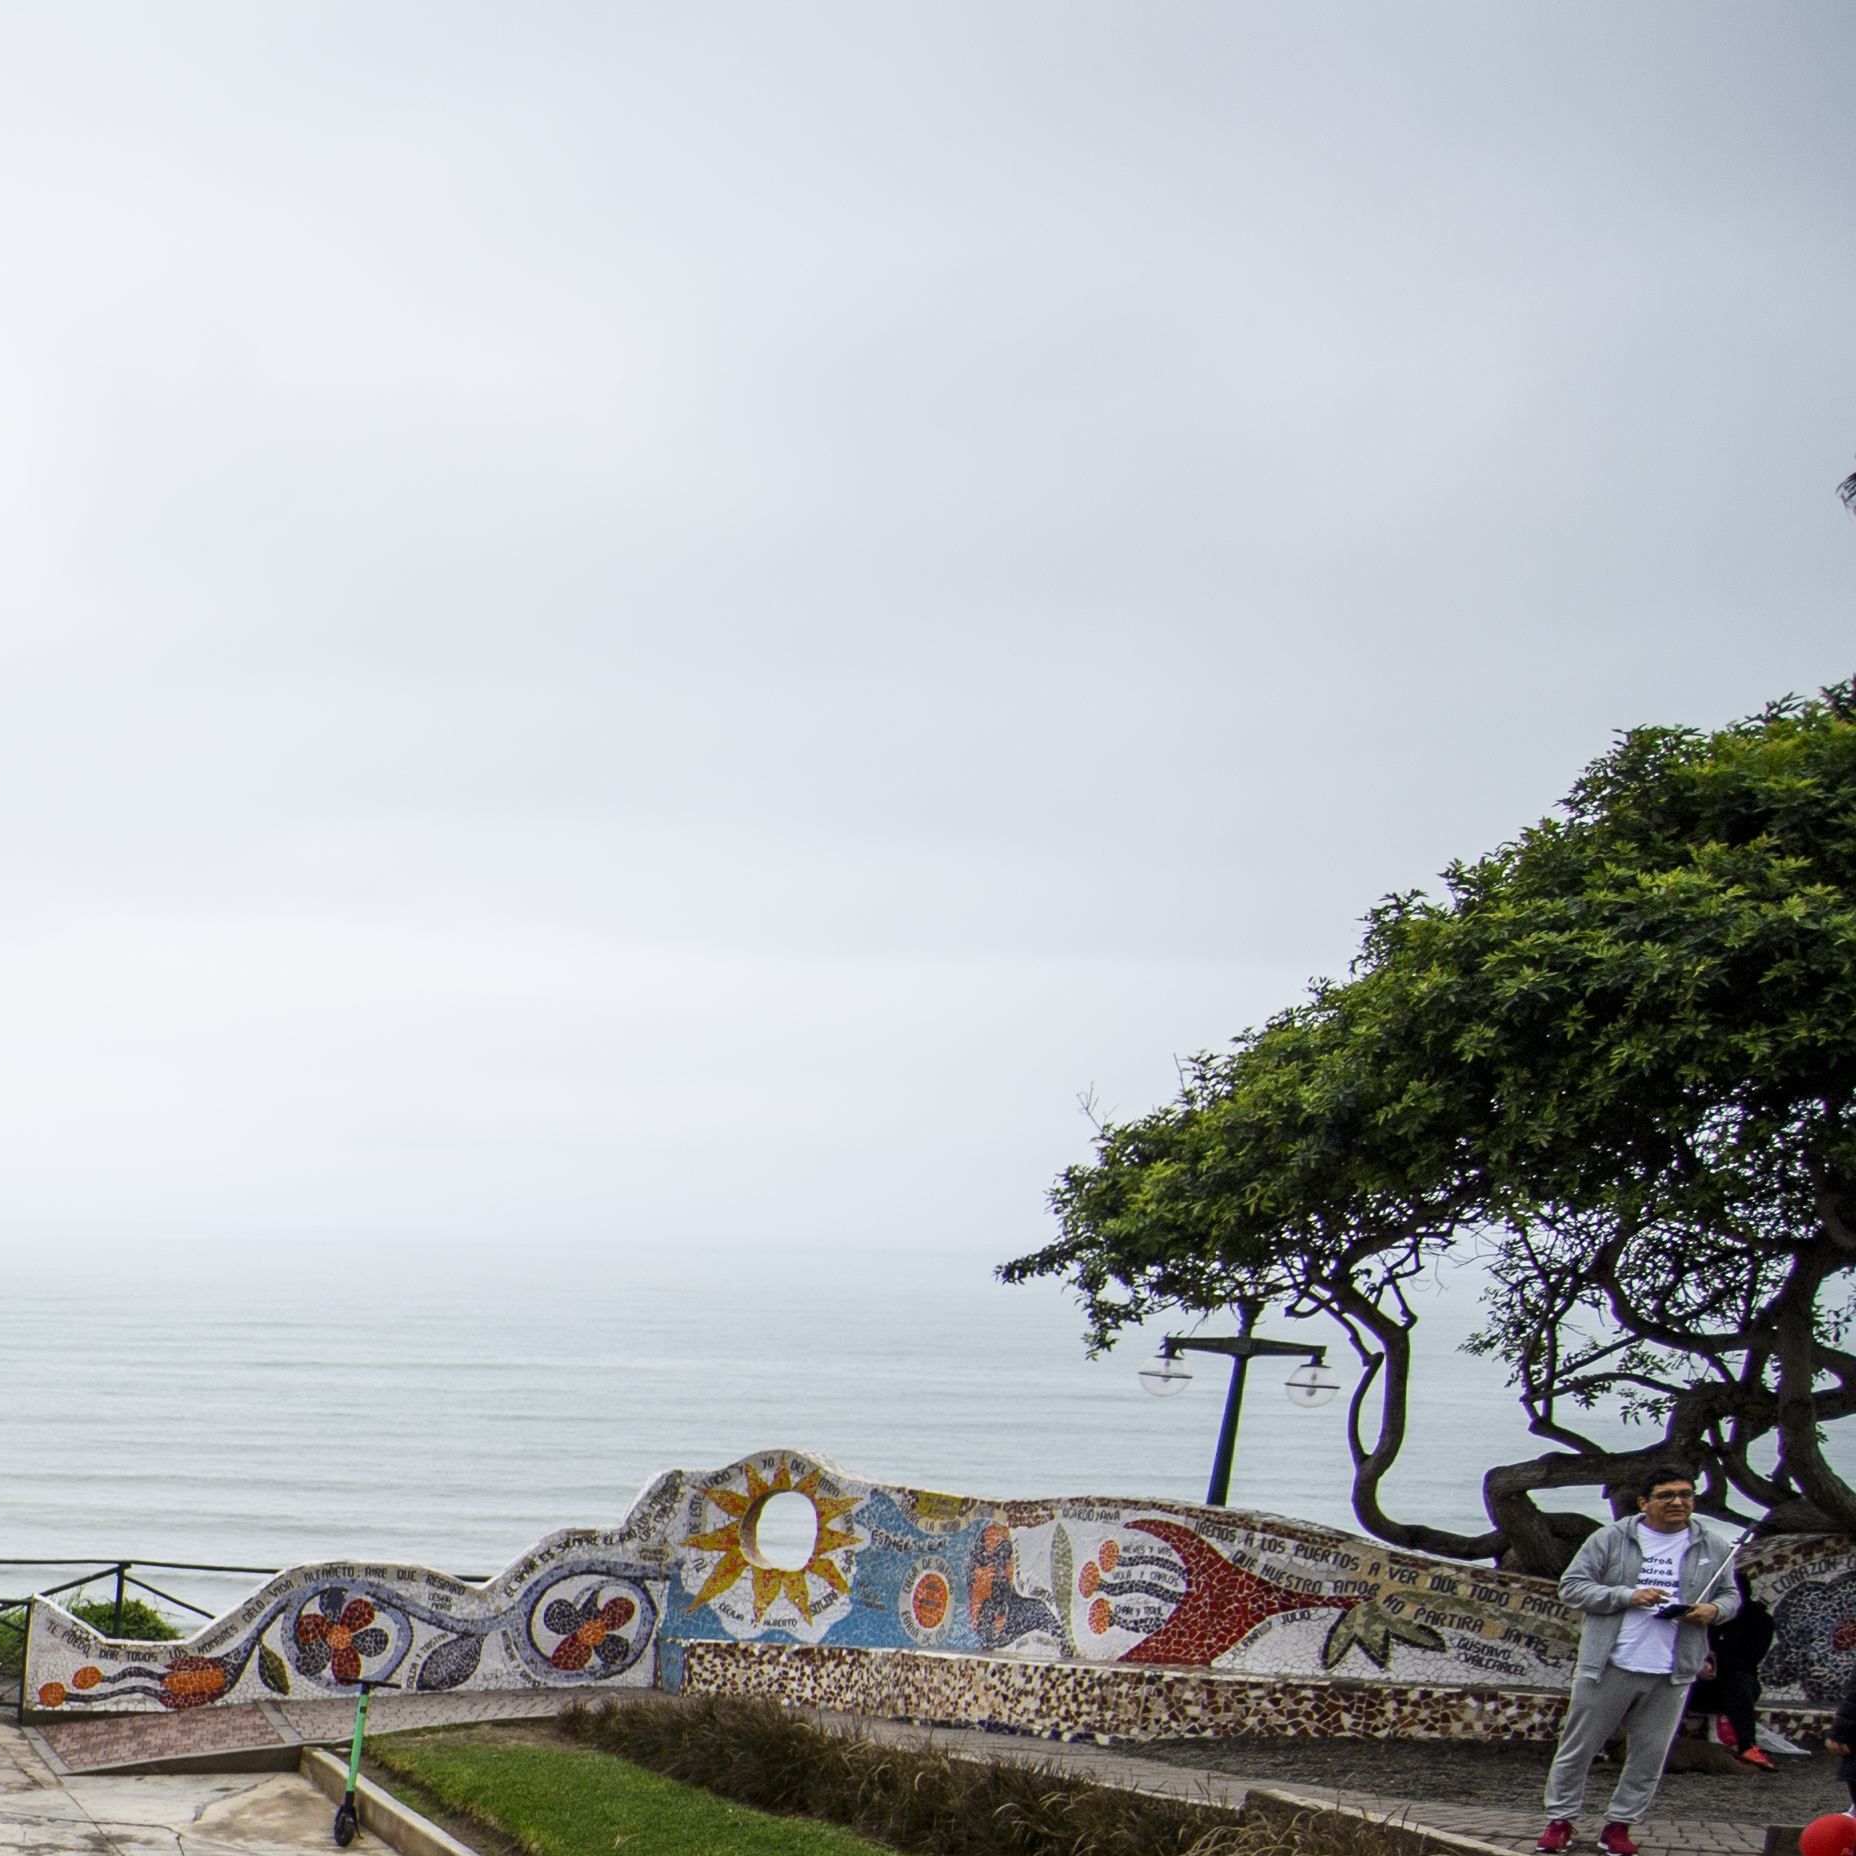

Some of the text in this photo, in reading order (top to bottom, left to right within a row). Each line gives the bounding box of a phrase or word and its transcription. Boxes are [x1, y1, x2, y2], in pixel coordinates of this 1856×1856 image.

[1193, 1520, 1237, 1543] IREMOS
[1244, 1531, 1256, 1547] A
[1260, 1536, 1286, 1554] LOS
[1293, 1543, 1360, 1572] PUERTOS
[1367, 1561, 1381, 1577] A
[1388, 1566, 1419, 1586] VER
[1468, 1583, 1511, 1608] TODO
[1332, 1580, 1382, 1597] AMOR
[99, 1648, 119, 1661] DAR
[126, 1650, 159, 1663] TODOS
[397, 1570, 417, 1582] QUE
[1382, 1593, 1406, 1616] NO
